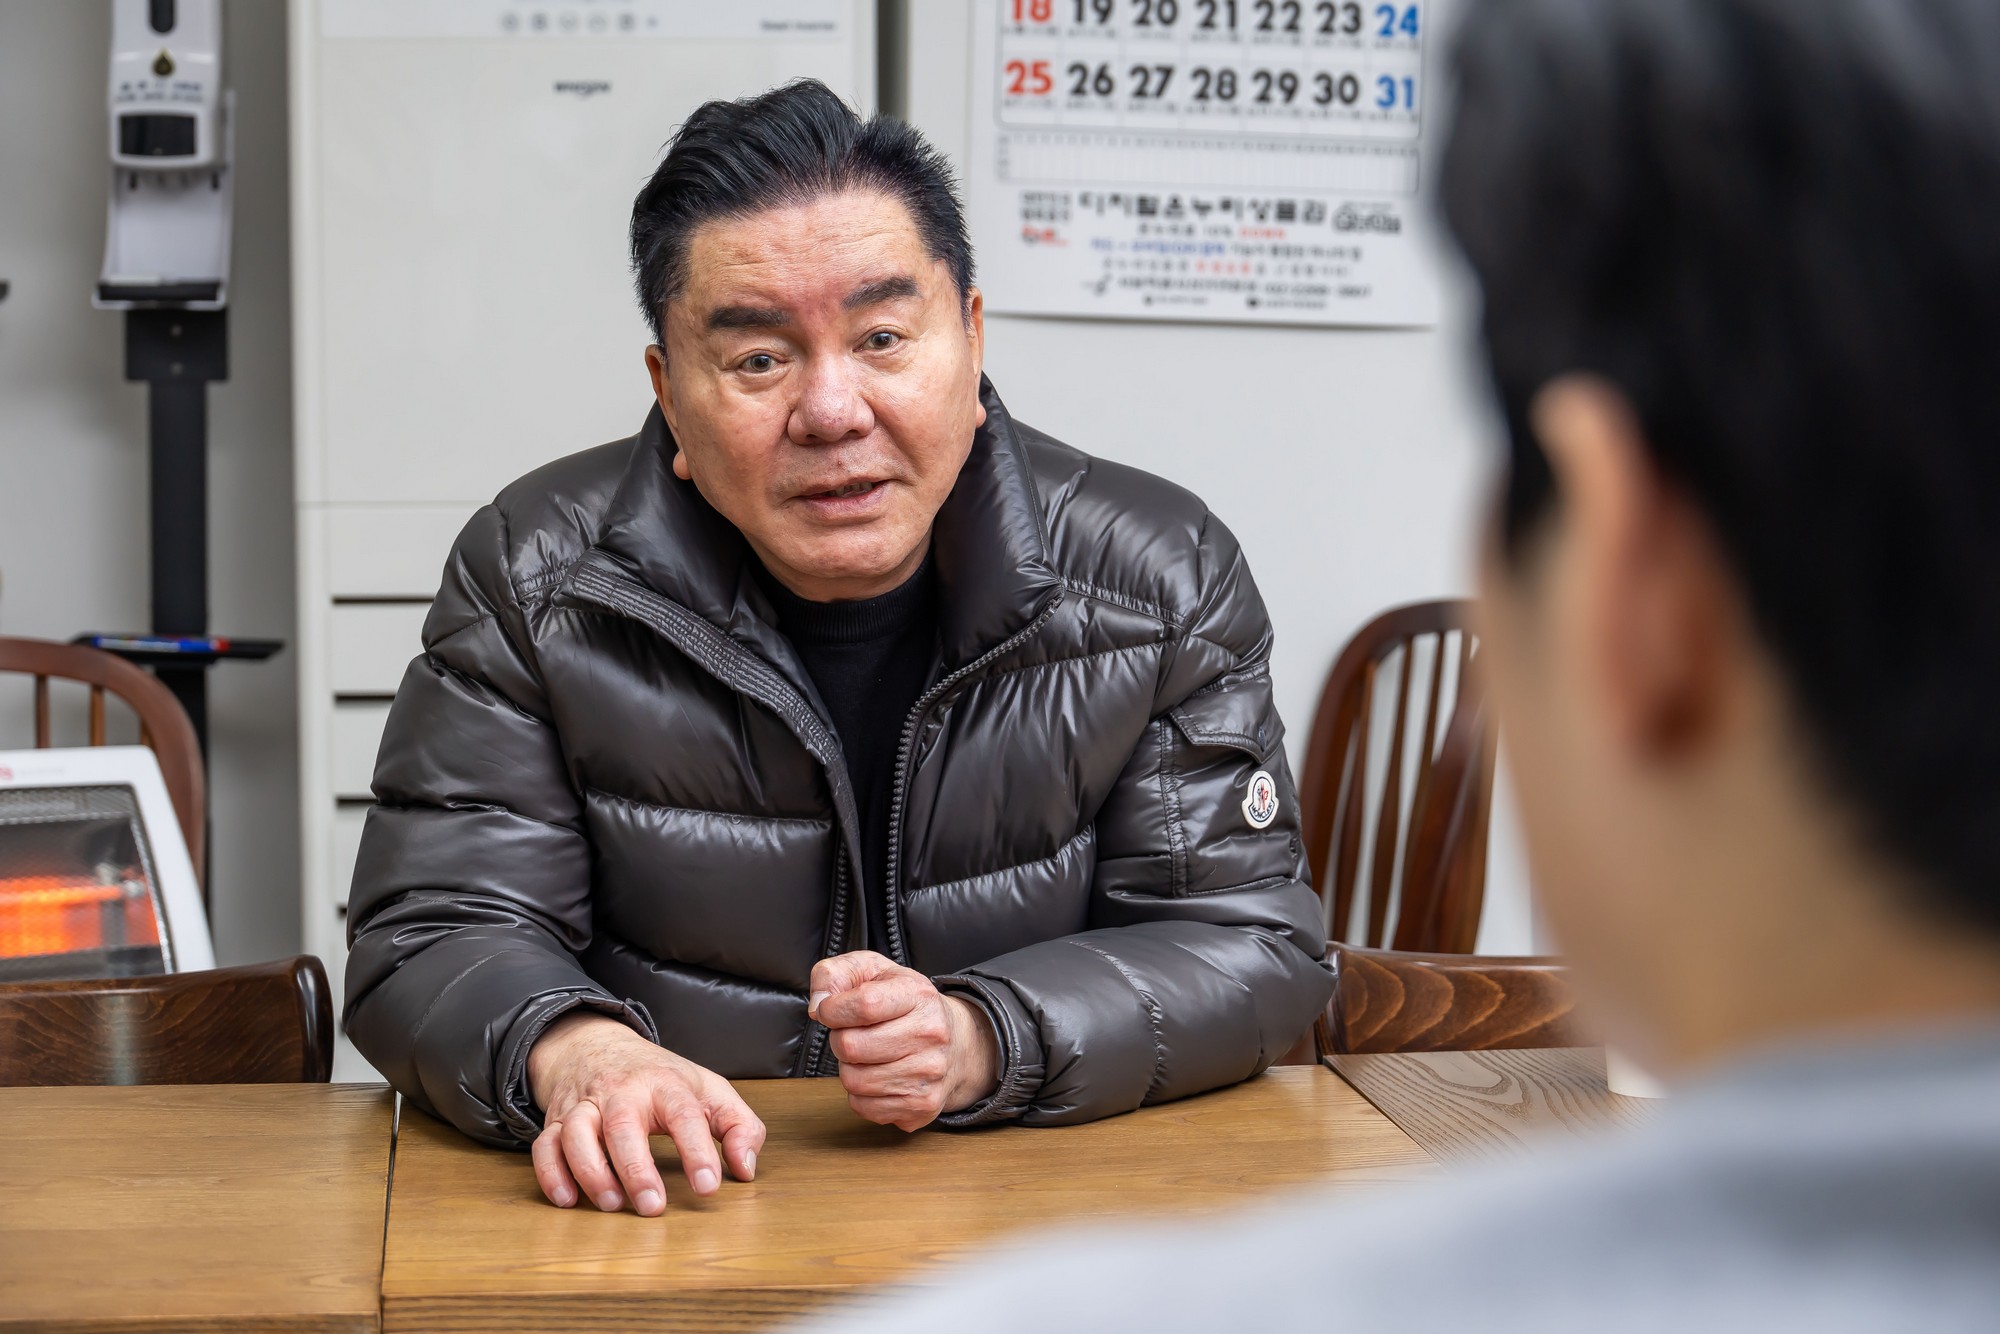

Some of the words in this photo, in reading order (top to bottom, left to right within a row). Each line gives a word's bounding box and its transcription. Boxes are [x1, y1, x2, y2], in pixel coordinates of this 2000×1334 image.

[1014, 0, 1053, 23] 18
[1073, 0, 1114, 25] 19
[1131, 0, 1178, 27] 20
[1196, 0, 1238, 31] 21
[1253, 0, 1301, 33] 22
[1315, 1, 1363, 35] 23
[1375, 4, 1420, 39] 24
[1005, 60, 1053, 95] 25
[1067, 62, 1115, 97] 26
[1129, 64, 1175, 100] 27
[1191, 67, 1238, 102] 28
[1252, 70, 1300, 104] 29
[1313, 72, 1360, 106] 30
[1376, 74, 1416, 110] 31
